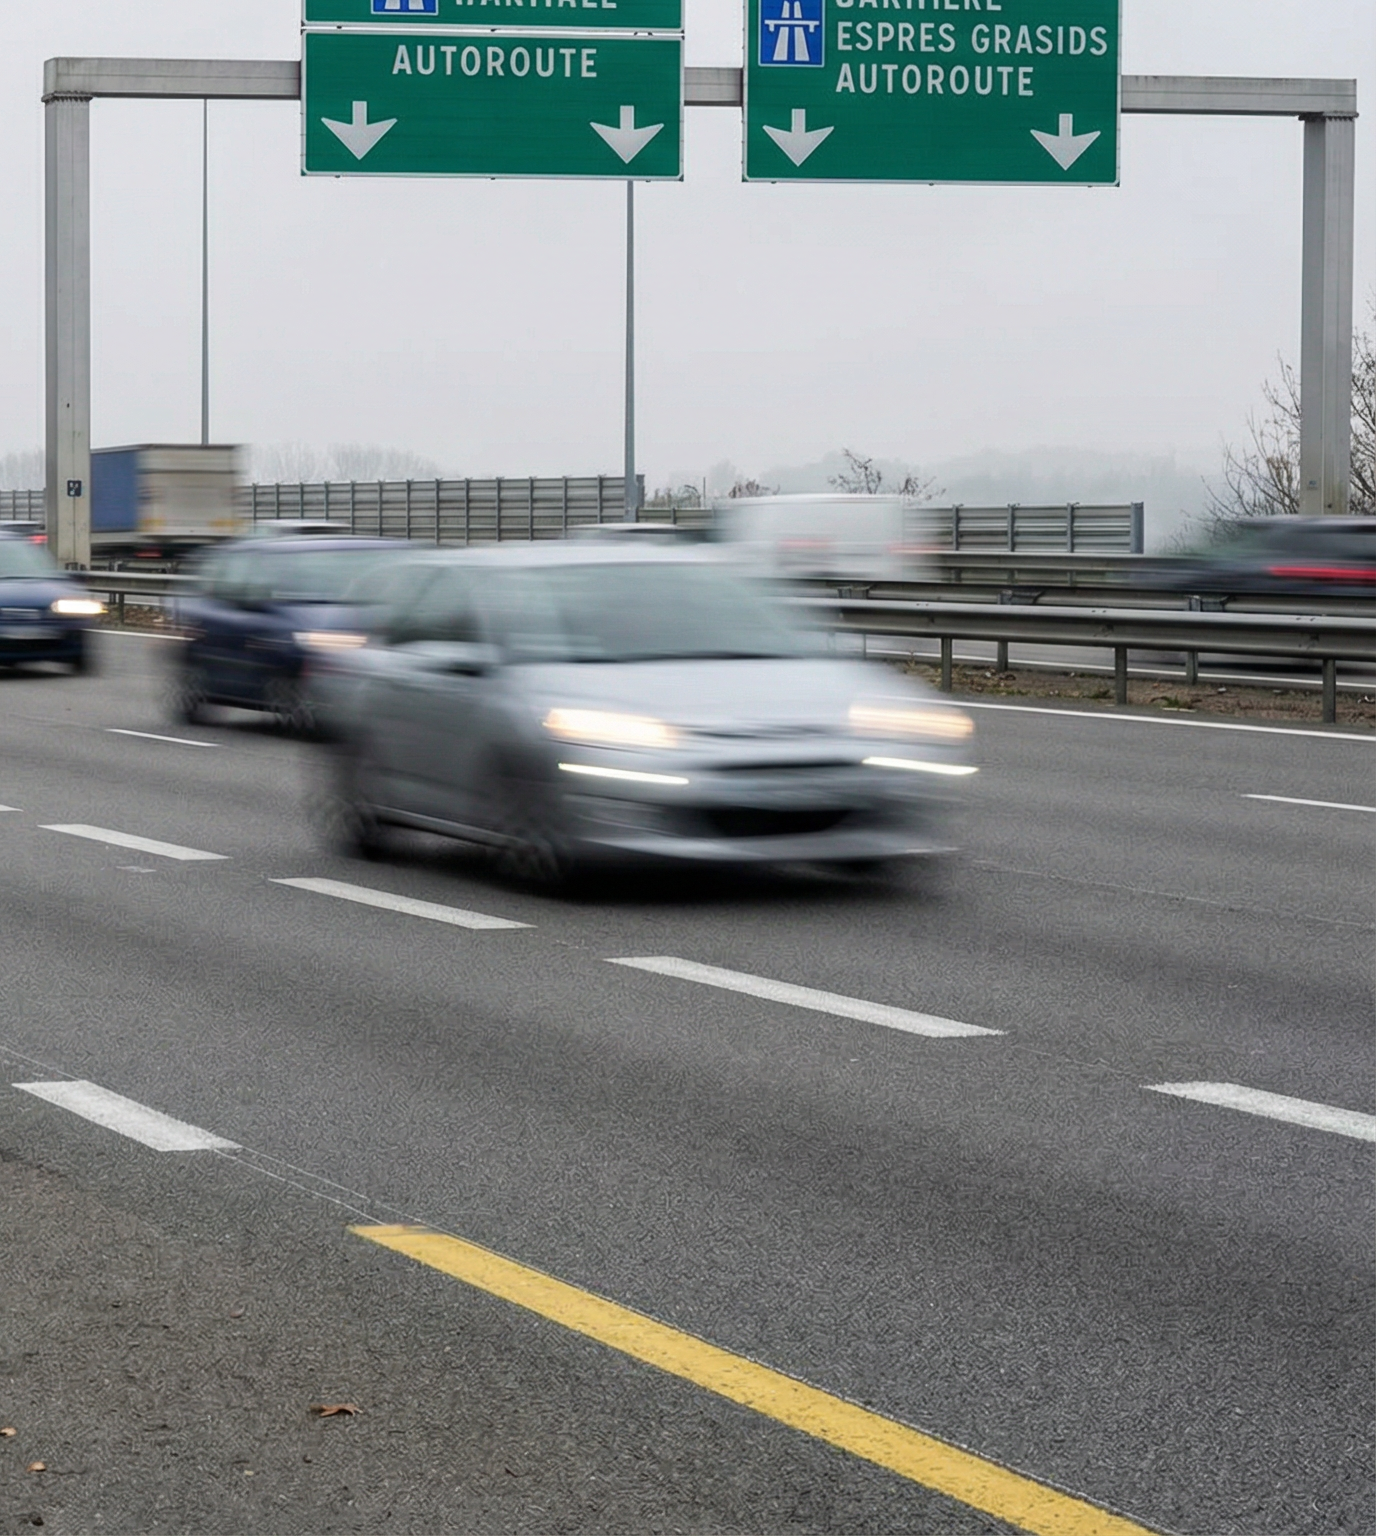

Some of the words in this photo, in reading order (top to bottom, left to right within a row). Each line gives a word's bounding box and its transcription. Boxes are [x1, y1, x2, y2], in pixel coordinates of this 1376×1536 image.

[837, 21, 956, 53] ESPRES
[971, 23, 1108, 56] GRASIDS
[392, 44, 597, 78] AUTOROUTE
[835, 62, 1034, 97] AUTOROUTE
